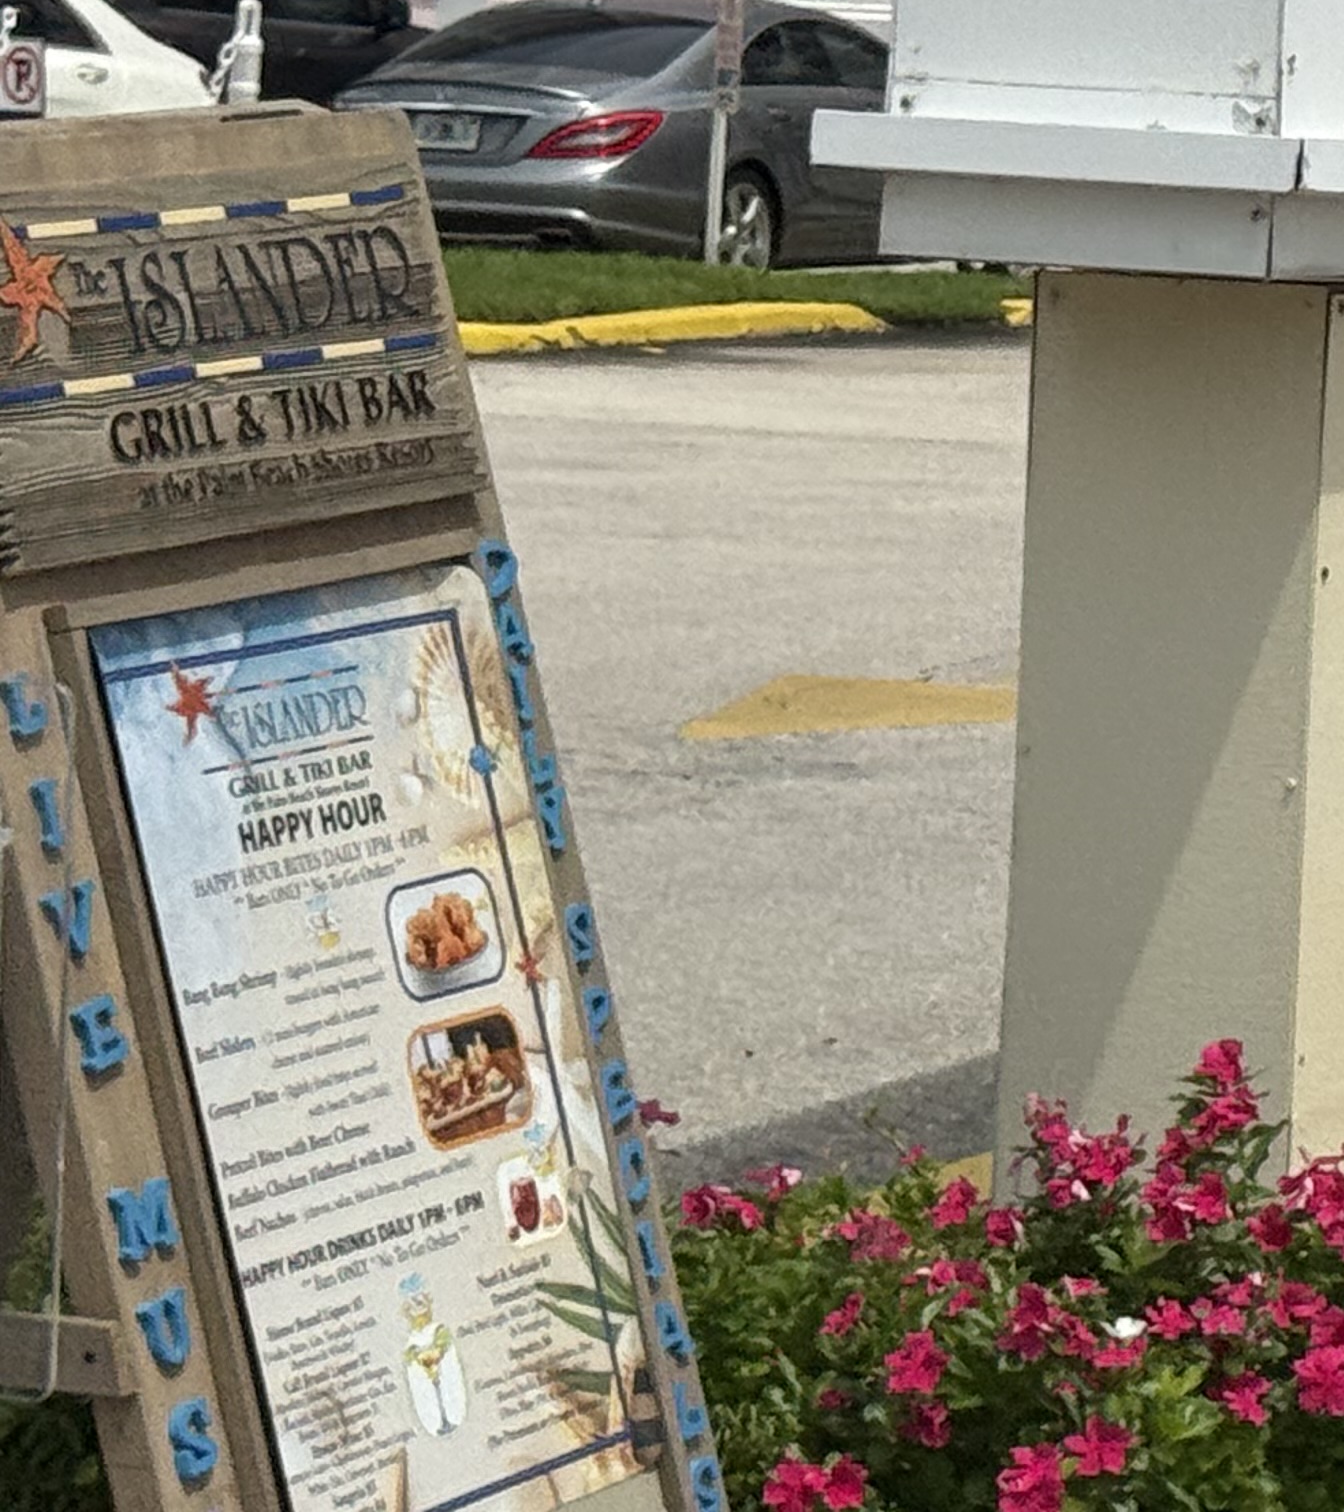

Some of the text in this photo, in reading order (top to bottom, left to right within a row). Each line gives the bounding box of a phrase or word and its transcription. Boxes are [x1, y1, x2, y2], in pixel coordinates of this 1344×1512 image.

[68, 226, 420, 354] The ISLANDER
[109, 368, 437, 464] GRILL & TIKI BAR
[241, 685, 372, 749] ISLANDER
[229, 750, 373, 798] GRILL & TIKI BAR
[237, 793, 387, 854] HAPPY HOUR
[241, 1257, 285, 1289] HAPPY
[287, 1244, 328, 1274] HOUR
[326, 1227, 378, 1260] DRINKS
[377, 1213, 414, 1243] DAILY
